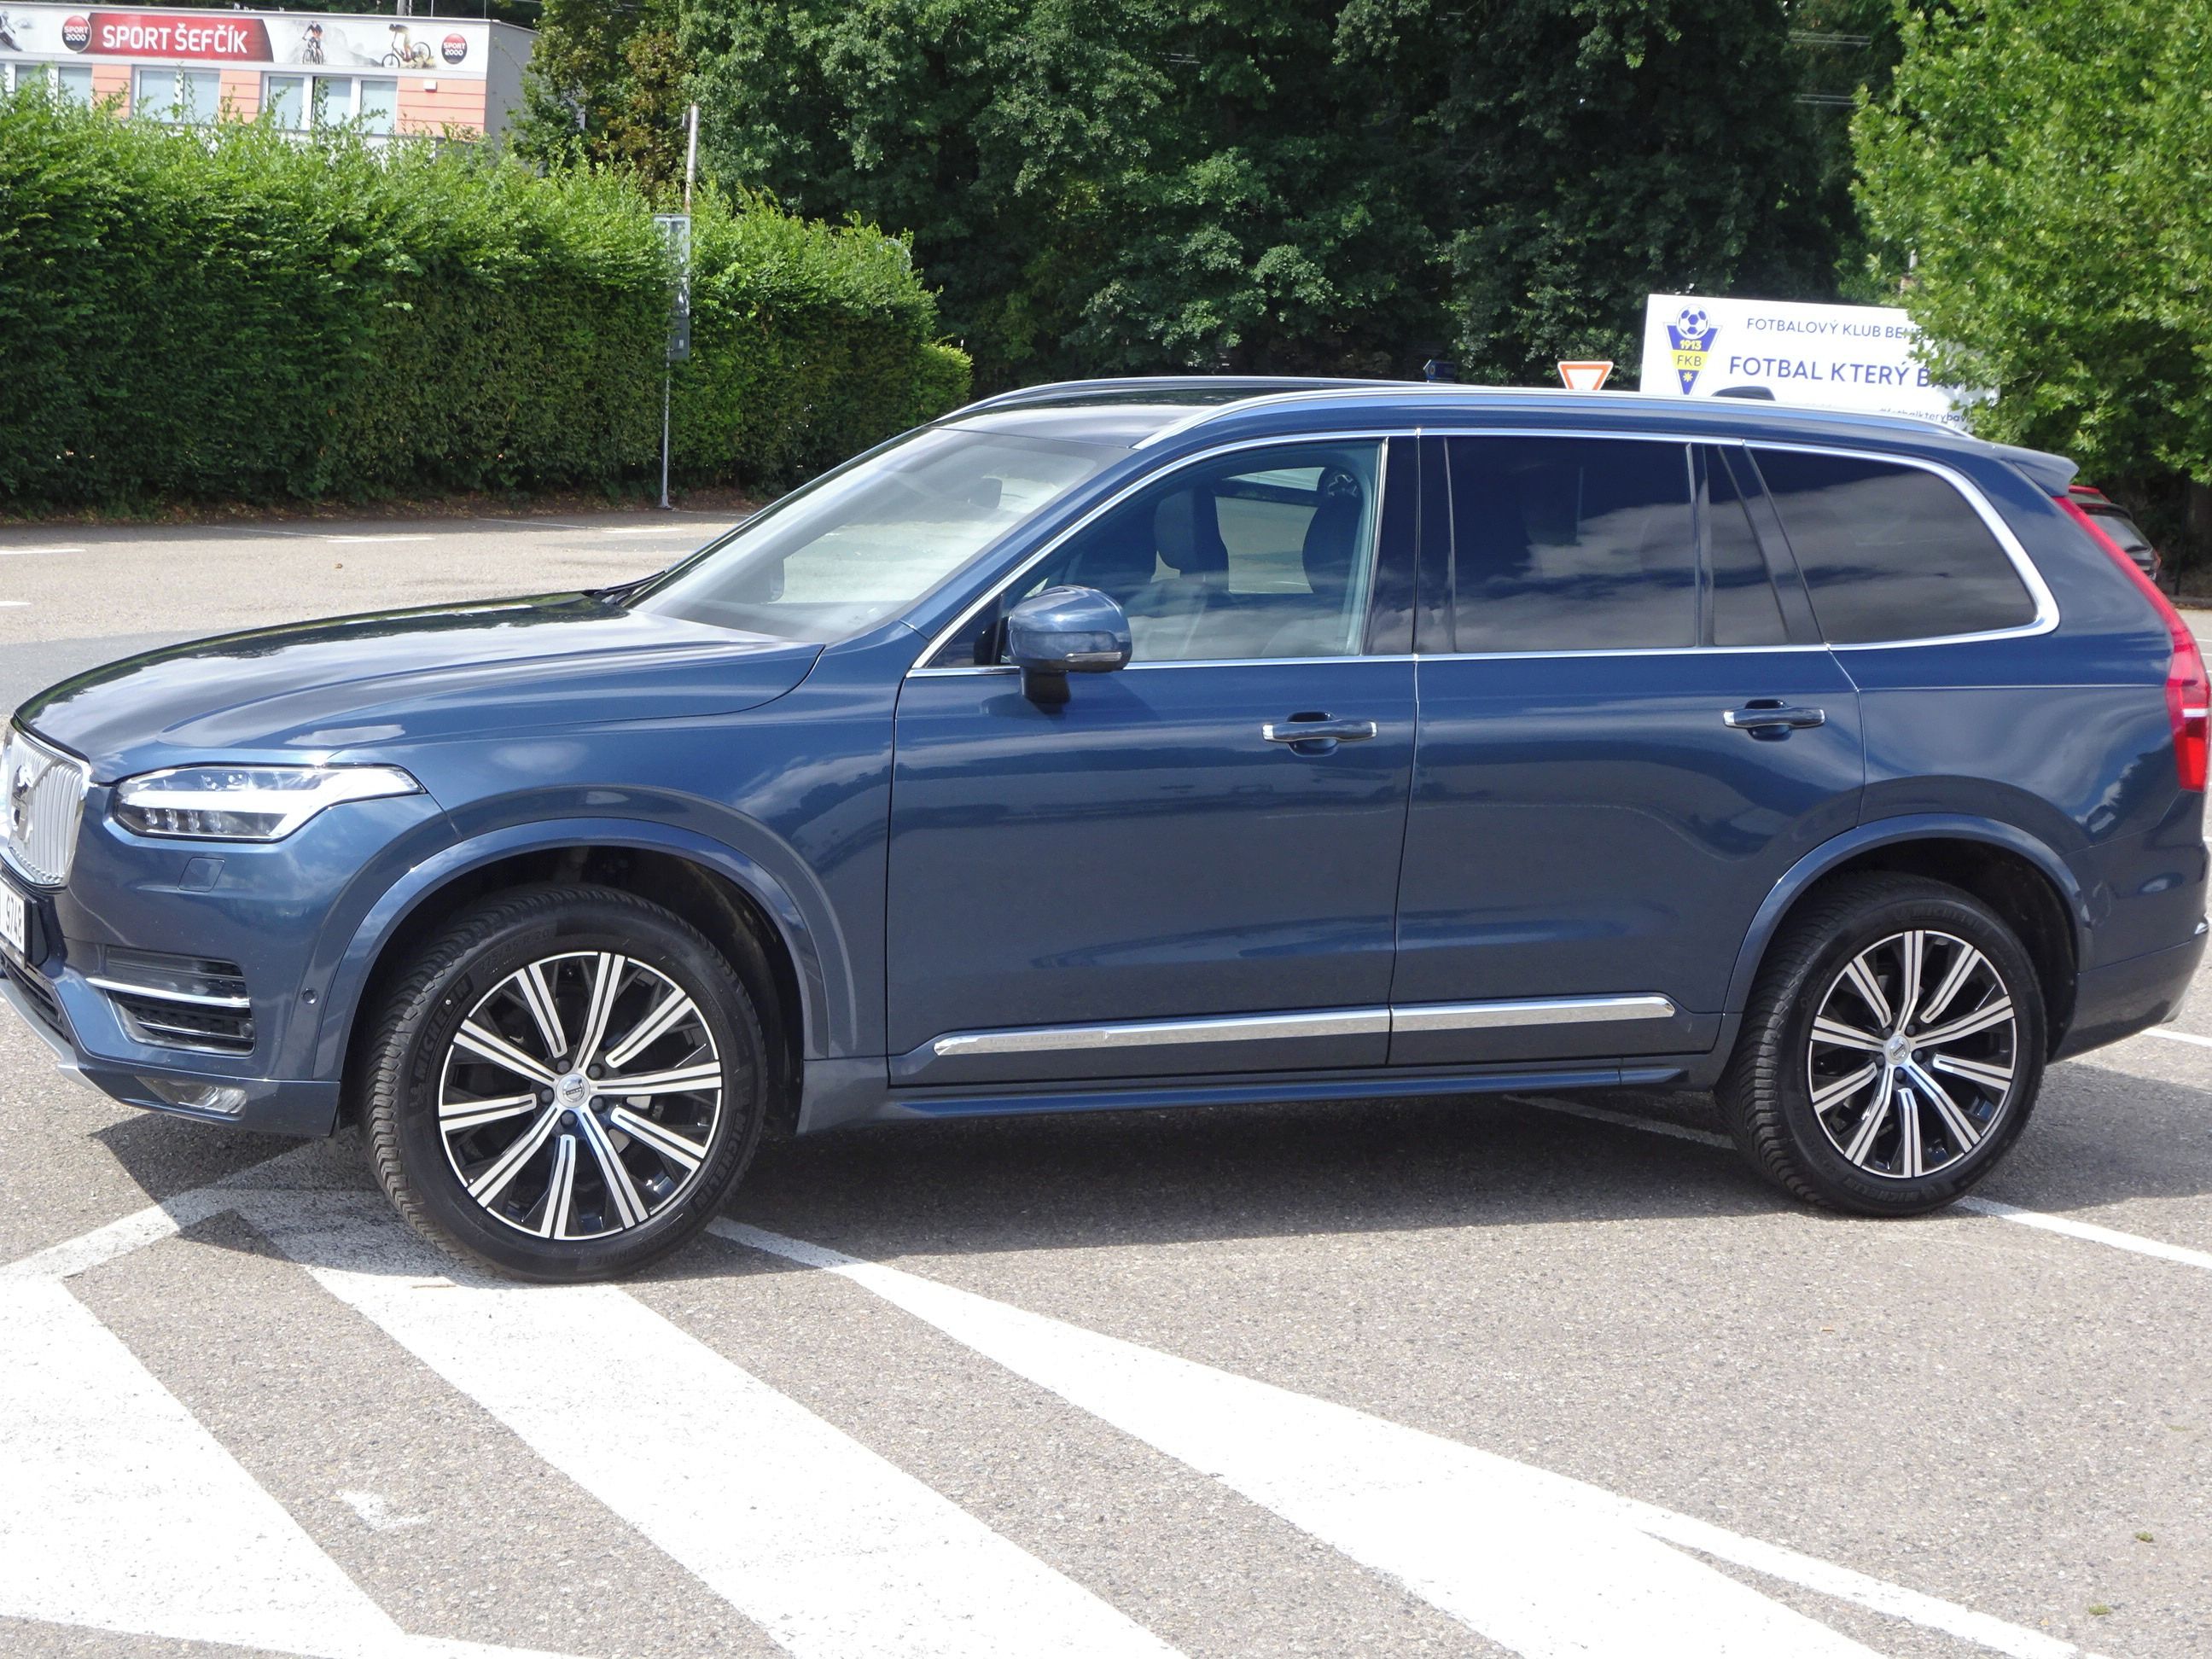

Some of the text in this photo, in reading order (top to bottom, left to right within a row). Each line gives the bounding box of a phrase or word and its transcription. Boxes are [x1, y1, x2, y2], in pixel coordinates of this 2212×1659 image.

[64, 26, 89, 35] SPORT
[66, 33, 86, 42] 2000
[102, 22, 248, 55] SPORT ŠEFČÍK
[1747, 317, 1839, 335] FOTBALOVÝ
[1842, 323, 1881, 337] KLUB
[1679, 339, 1703, 351] 1913
[1677, 355, 1702, 367] FKB
[1729, 356, 1823, 381] FOTBAL
[1831, 361, 1910, 386] KTERÝ
